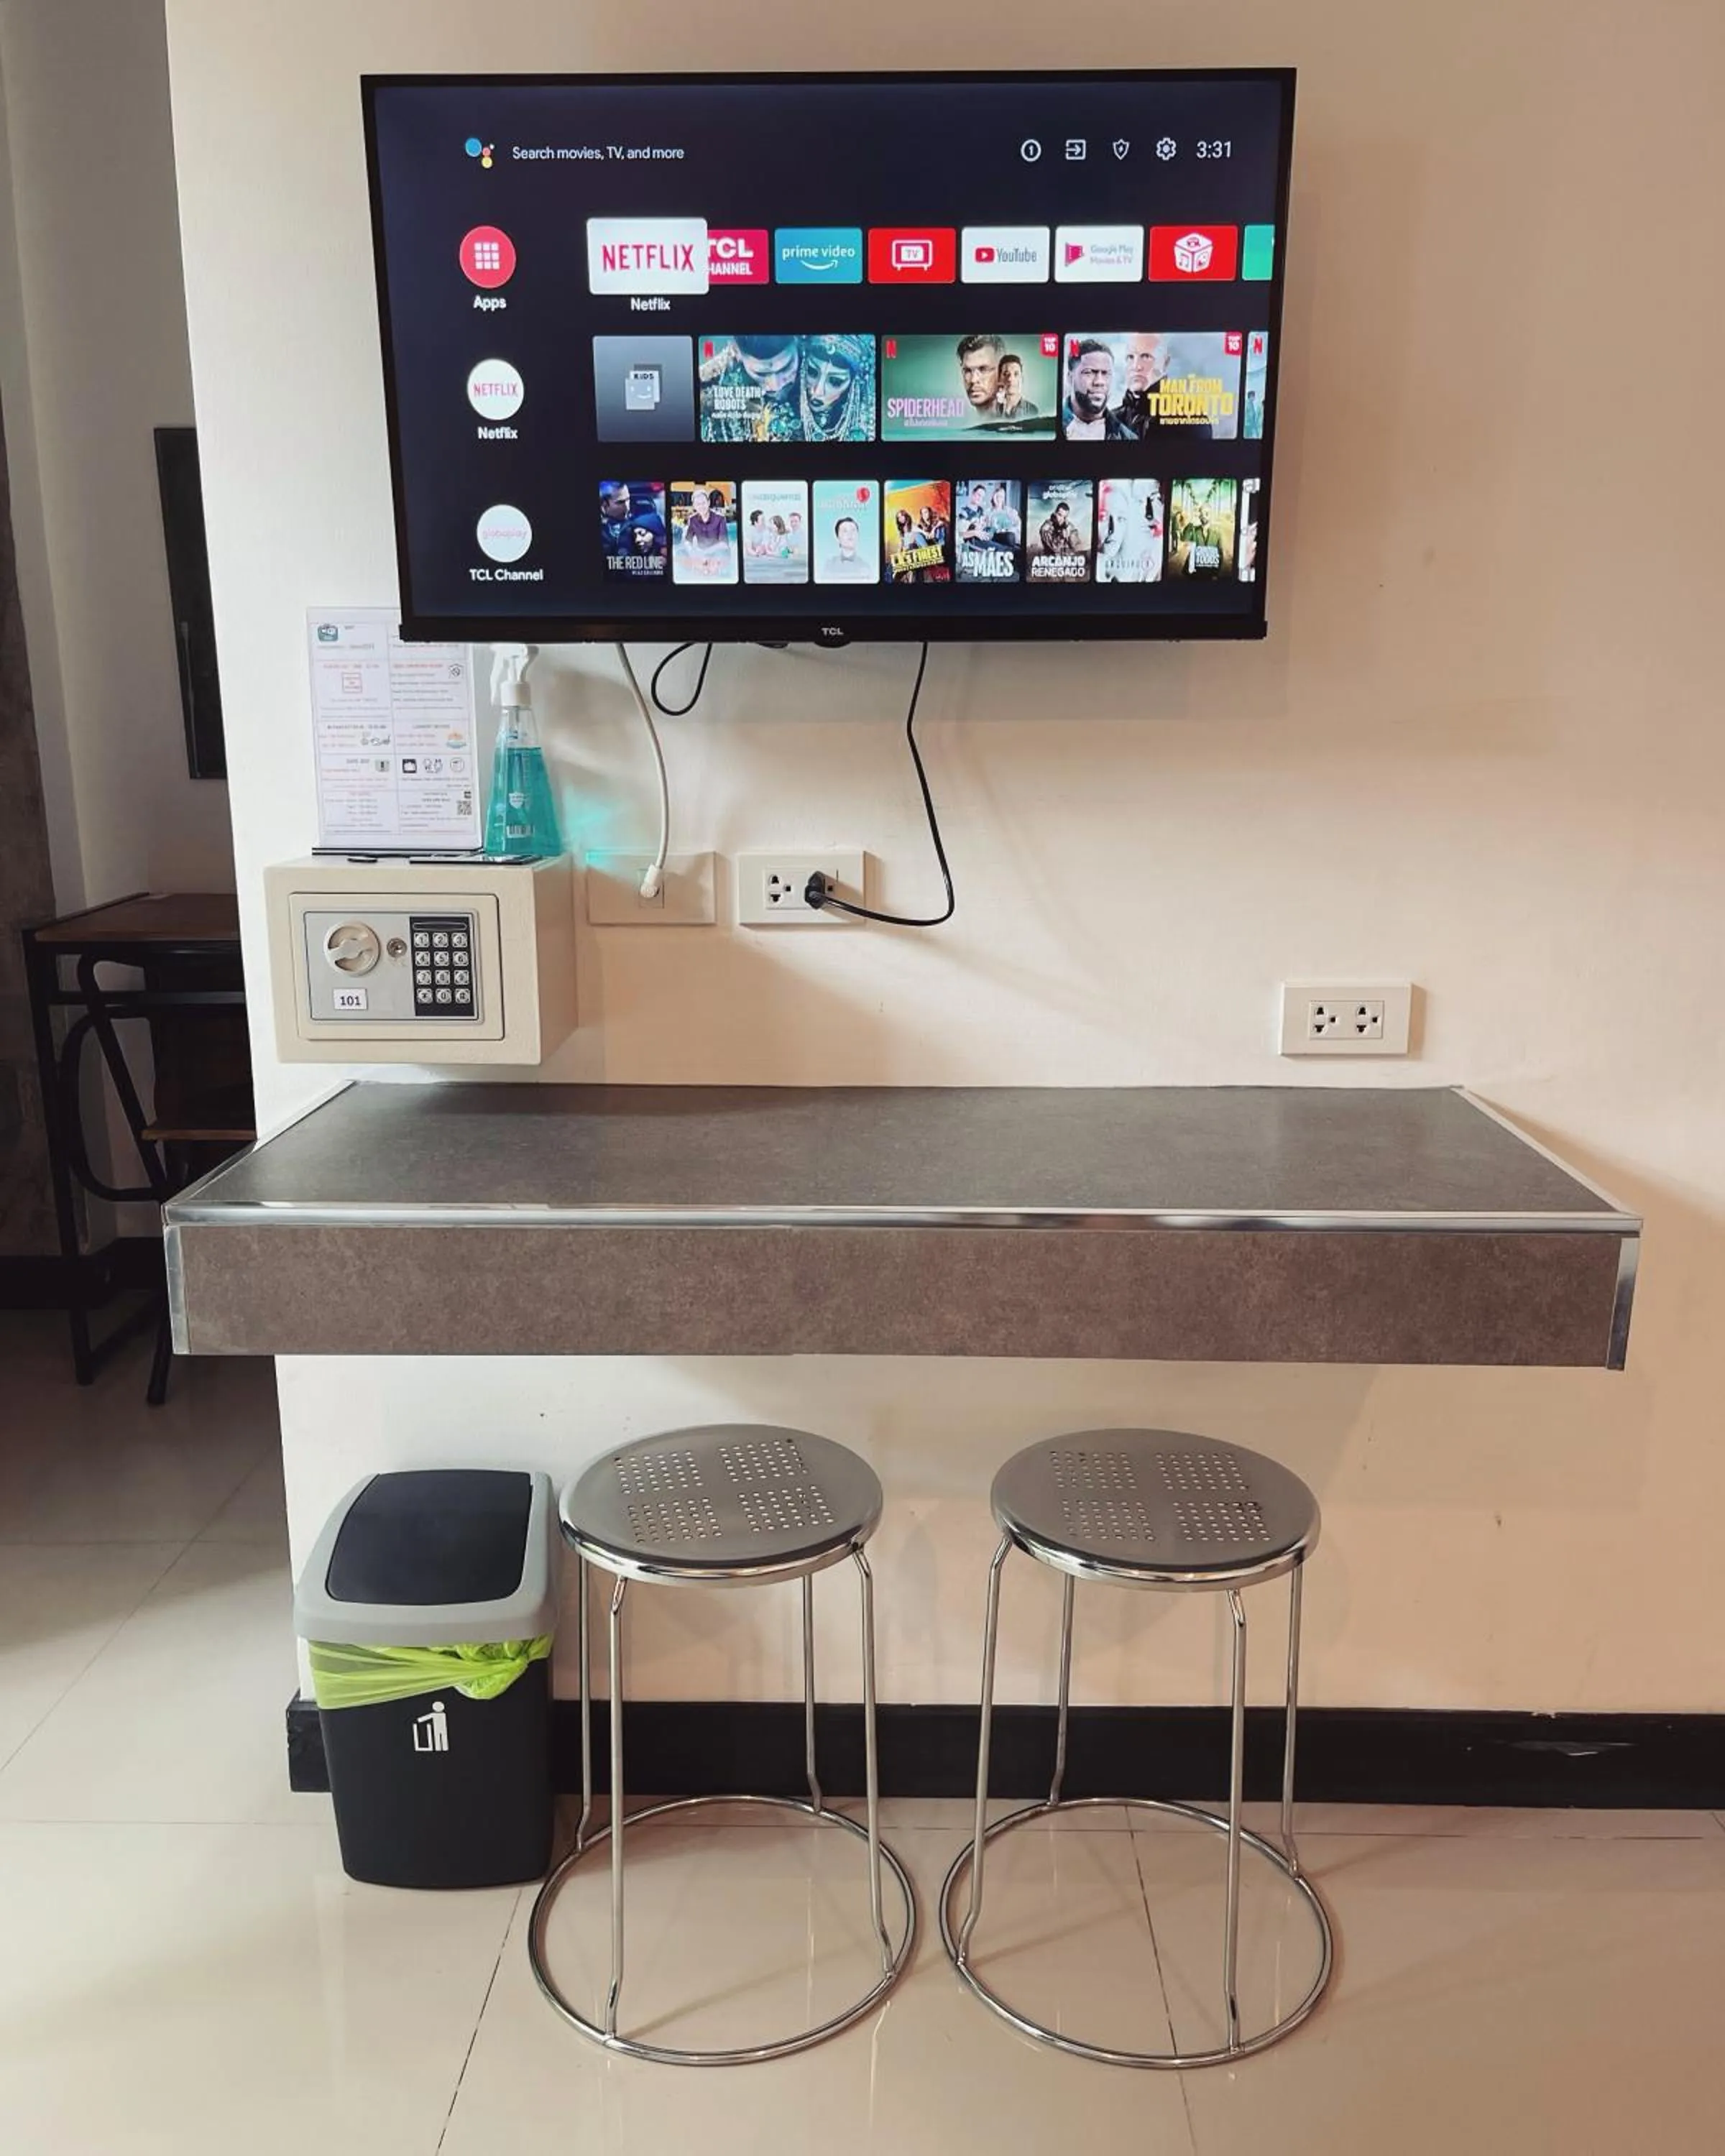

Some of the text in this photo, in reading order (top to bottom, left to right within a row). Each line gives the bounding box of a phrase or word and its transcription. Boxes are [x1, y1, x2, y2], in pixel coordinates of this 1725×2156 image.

[512, 146, 685, 160] Search movies, TV, and more
[1196, 141, 1231, 158] 3:31
[707, 237, 754, 259] TCL
[782, 244, 855, 260] prime video
[906, 249, 919, 259] TV
[997, 247, 1037, 263] YouTube
[1090, 245, 1134, 255] Google Play
[602, 244, 694, 272] NETFLIX
[1090, 256, 1114, 264] Movies
[1123, 256, 1133, 264] TV
[707, 262, 753, 275] HANNEL
[474, 295, 507, 312] Apps
[630, 297, 671, 311] Netflix
[473, 382, 518, 397] NETFLIX
[1159, 378, 1223, 393] MAN FROM
[887, 397, 965, 418] SPIDERHEAD
[1148, 392, 1234, 415] TORONTO
[477, 426, 518, 440] Netflix
[607, 556, 625, 570] THE
[625, 556, 643, 570] RED
[644, 556, 663, 570] LINE
[1032, 555, 1086, 567] ARCANJO
[469, 568, 543, 581] TCL Channel
[1031, 566, 1085, 578] RENEGADO
[821, 627, 844, 636] TCL
[339, 995, 362, 1006] 101
